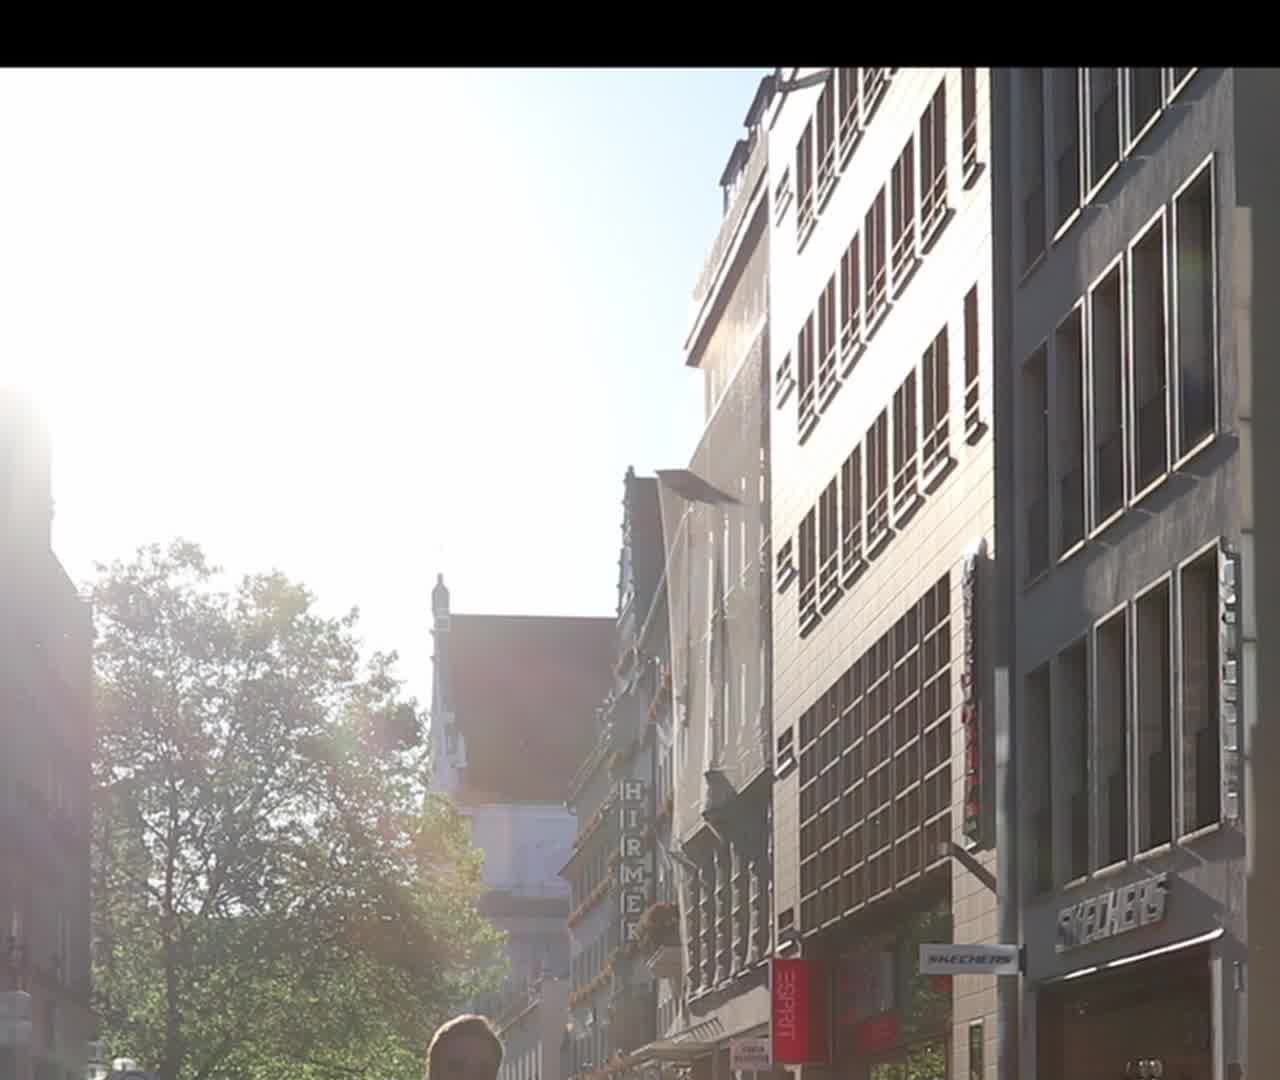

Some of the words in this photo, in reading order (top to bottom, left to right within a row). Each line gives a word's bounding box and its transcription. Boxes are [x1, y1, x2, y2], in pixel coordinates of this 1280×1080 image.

[625, 782, 644, 941] HIRMER
[1056, 873, 1170, 953] SKECHERS
[927, 953, 1014, 967] SKECHERS
[775, 969, 797, 1041] ESPRIT
